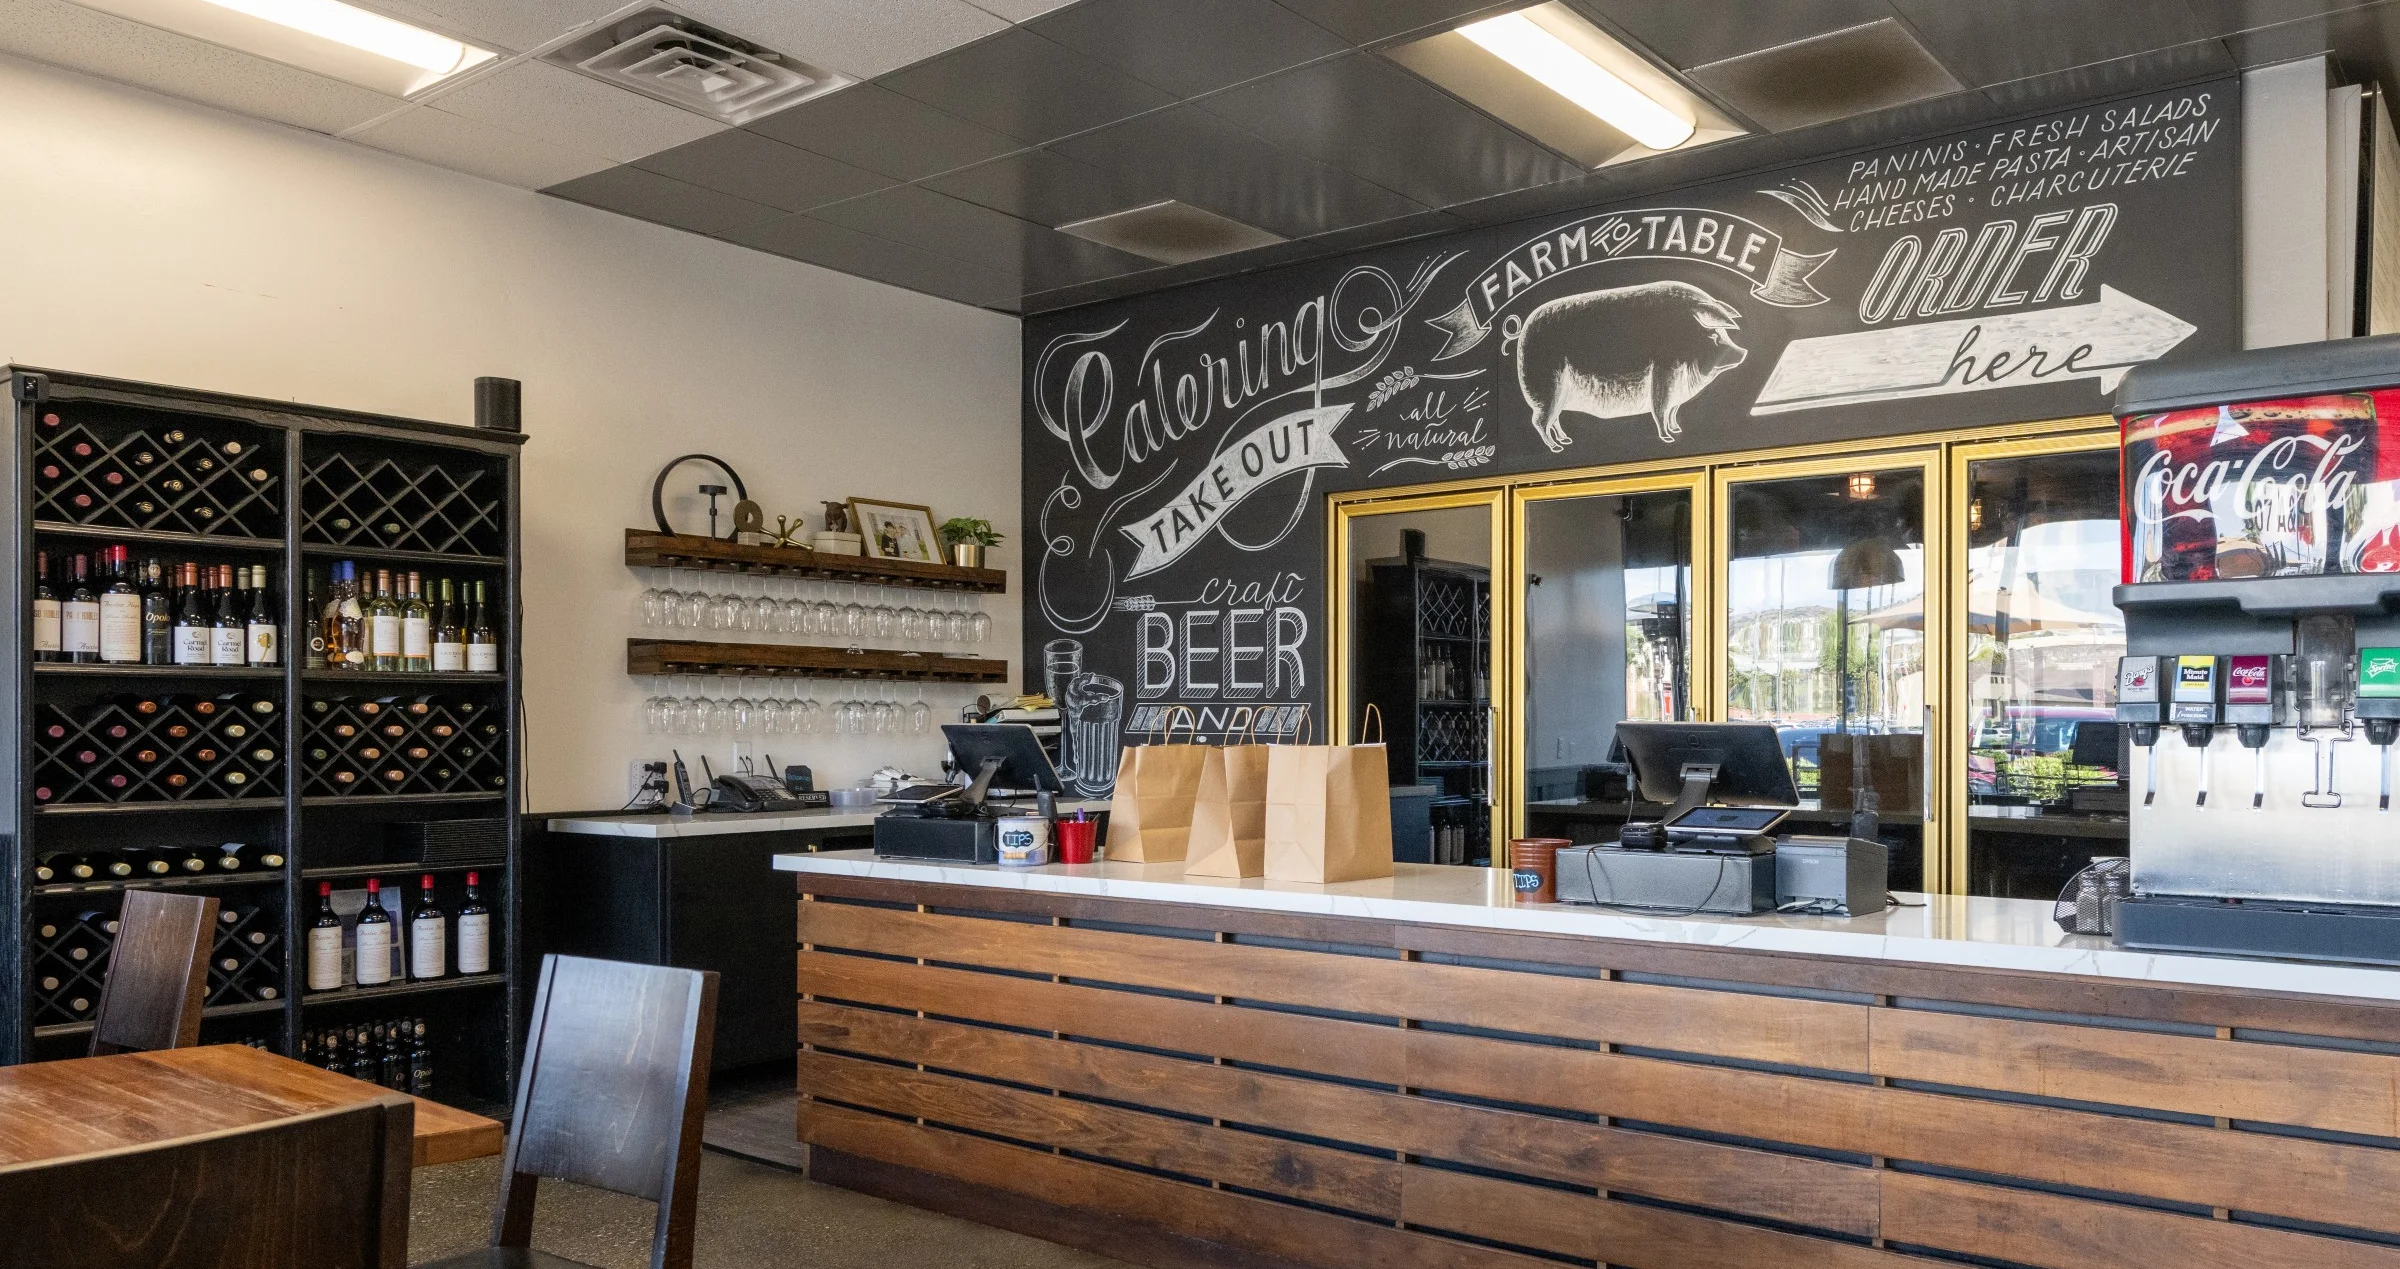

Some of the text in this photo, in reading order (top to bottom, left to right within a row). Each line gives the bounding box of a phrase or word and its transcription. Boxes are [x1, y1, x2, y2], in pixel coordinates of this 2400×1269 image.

[1834, 118, 2220, 212] HAND MADE PASTA ARTISAN
[1847, 93, 2211, 184] PANINIS FRESH SALADS
[1850, 151, 2198, 233] CHEESES CHARCUTERIE
[1480, 214, 1767, 312] FARM TO TABLE
[1858, 203, 2119, 325] ORDER
[1063, 295, 1326, 490] Catering
[1940, 324, 2095, 386] here
[1384, 418, 1487, 450] natural
[1405, 391, 1457, 421] all
[1150, 418, 1315, 555] TAKE OUT
[2134, 433, 2366, 525] Coca-Cola
[1198, 571, 1306, 611] craft
[1136, 607, 1308, 699] BEER
[1172, 706, 1253, 731] AND
[1004, 833, 1033, 846] TIPS
[1512, 873, 1540, 888] TIPS
